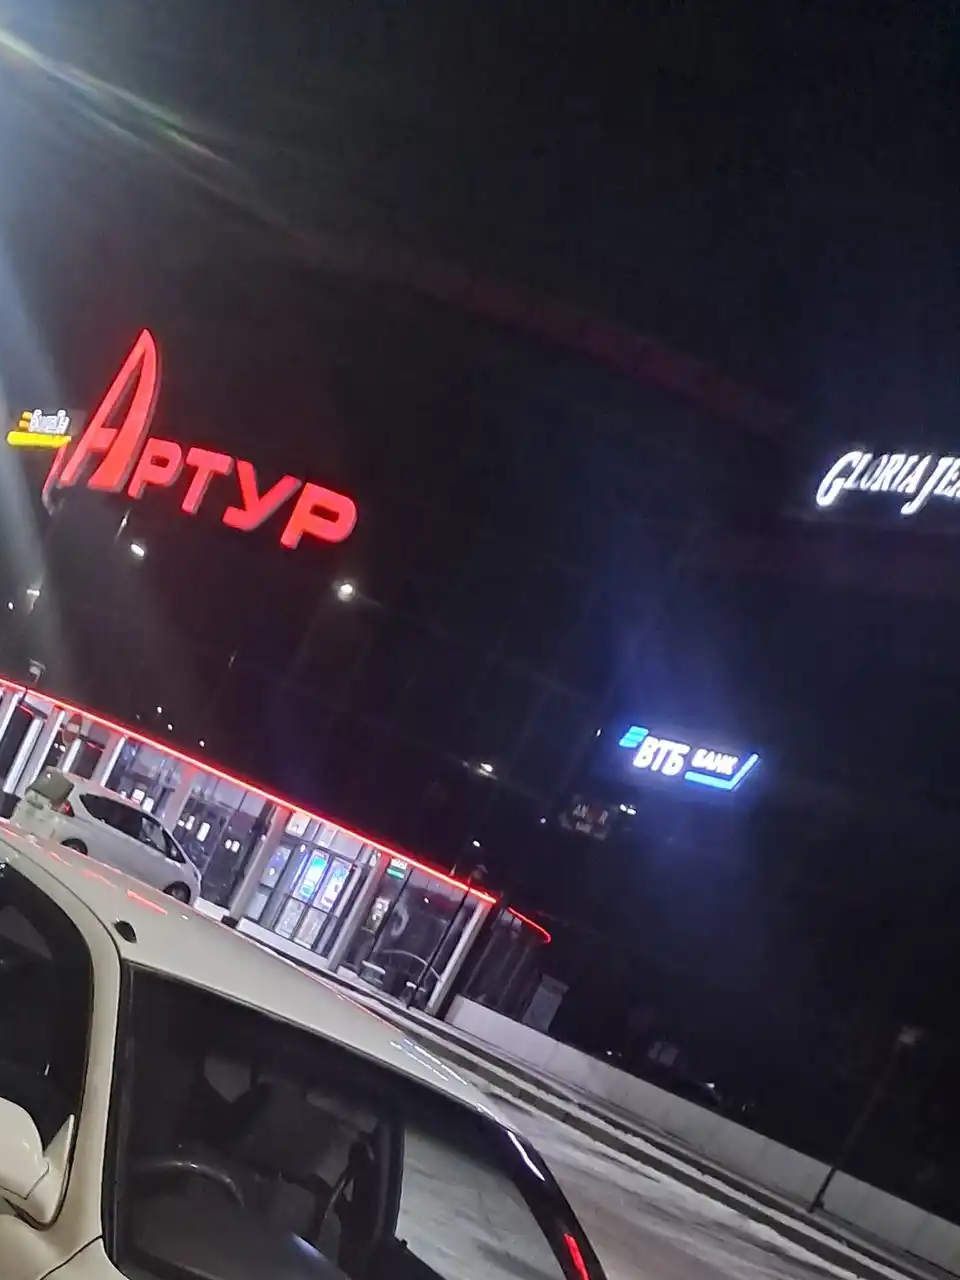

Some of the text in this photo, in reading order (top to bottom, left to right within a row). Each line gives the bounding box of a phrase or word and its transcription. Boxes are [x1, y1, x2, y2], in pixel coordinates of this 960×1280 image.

[816, 450, 960, 515] GLORIA JE
[632, 735, 690, 776] ВТБ
